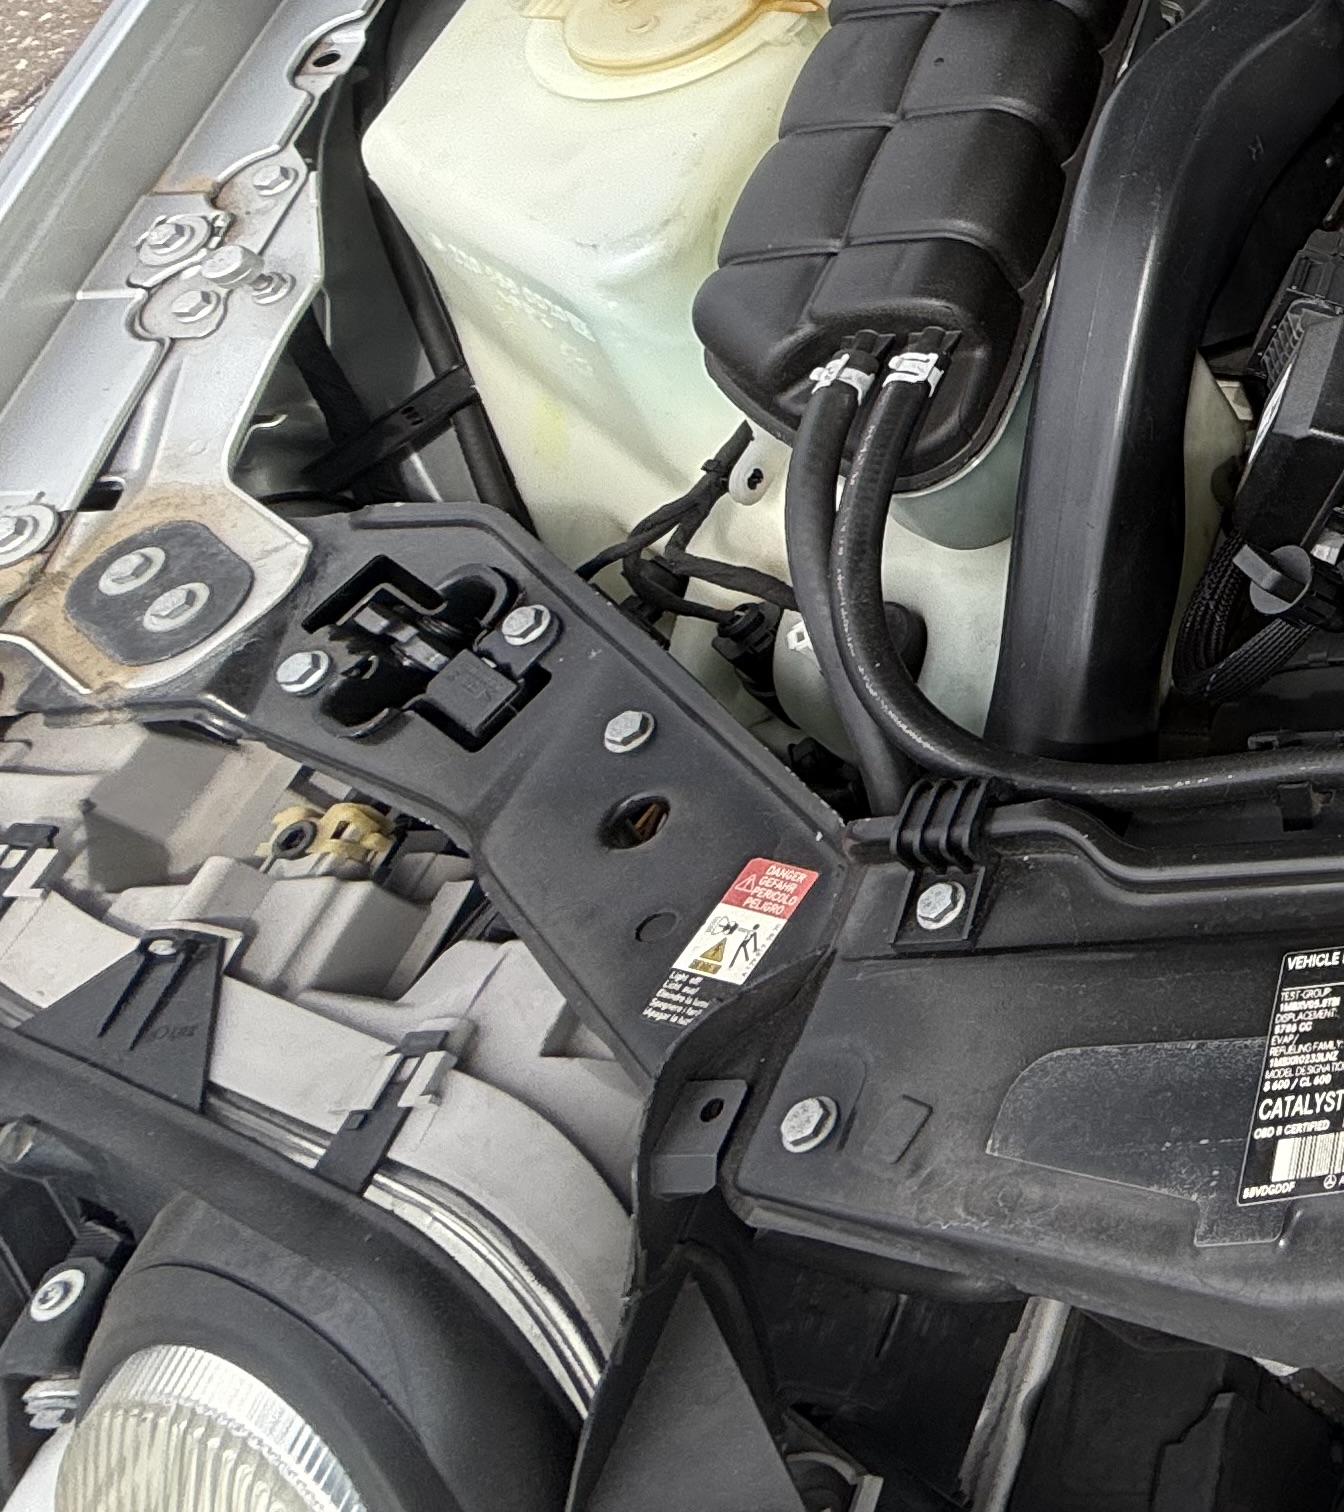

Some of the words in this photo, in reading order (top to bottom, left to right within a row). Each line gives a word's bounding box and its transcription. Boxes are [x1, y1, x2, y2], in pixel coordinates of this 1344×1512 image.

[765, 865, 806, 884] DANGER
[758, 876, 798, 893] GEFAHR
[751, 887, 798, 906] PERICOLO
[742, 897, 785, 915] PELIGRO
[1286, 951, 1340, 970] VEHICLE
[1264, 1067, 1294, 1079] MODEL
[1283, 1119, 1330, 1135] CERTIFIED
